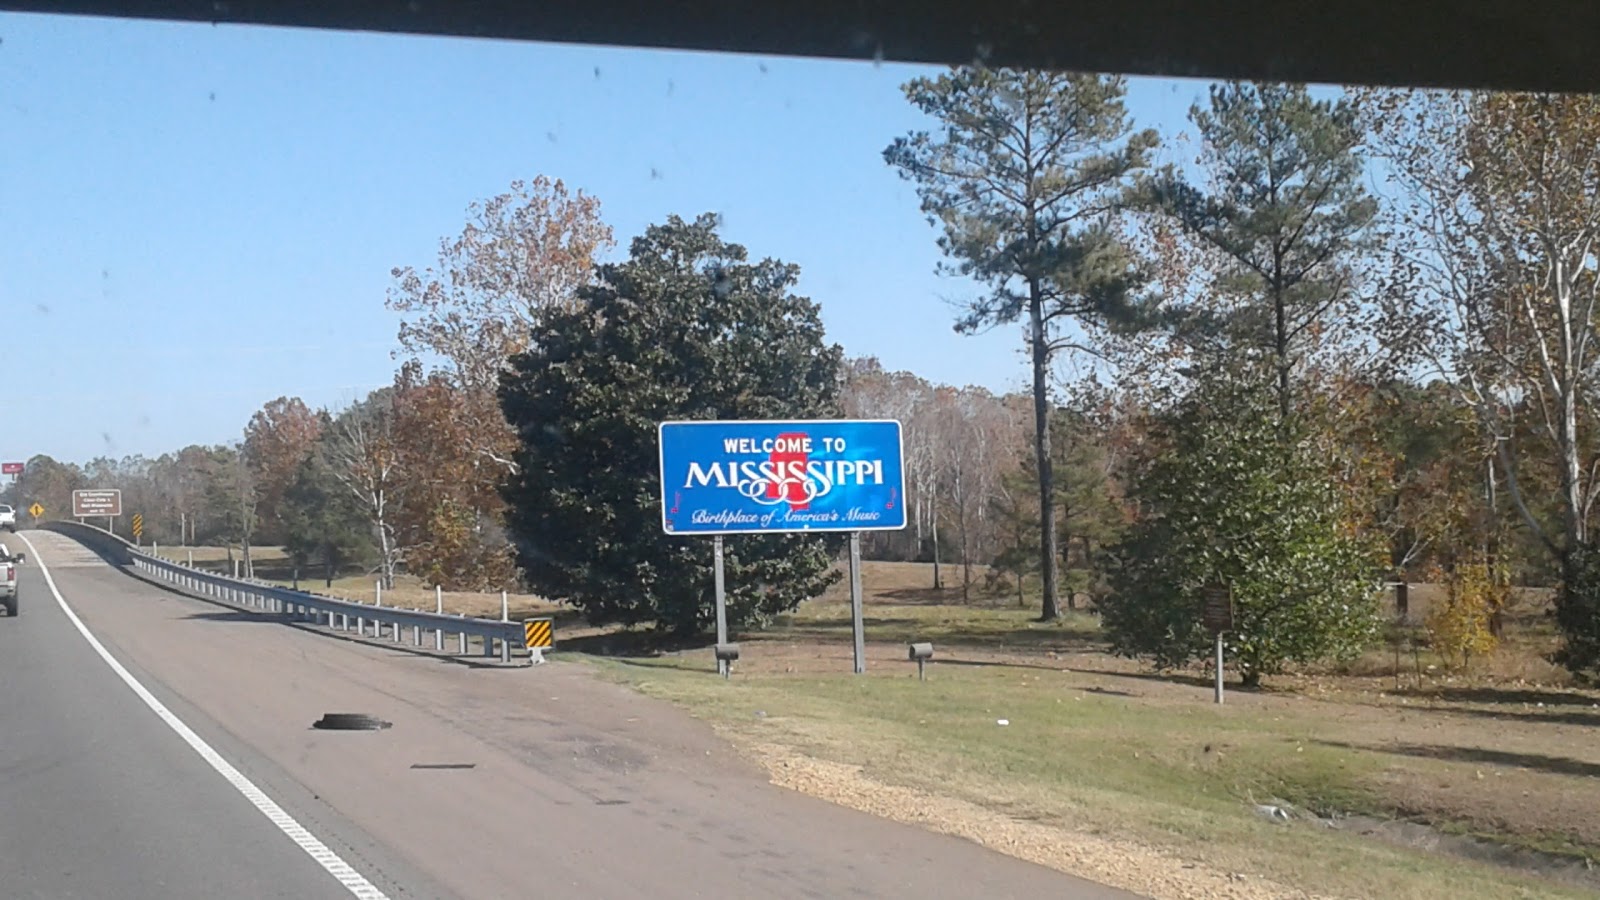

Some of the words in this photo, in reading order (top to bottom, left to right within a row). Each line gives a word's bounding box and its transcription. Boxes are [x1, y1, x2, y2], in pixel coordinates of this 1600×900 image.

[724, 438, 813, 453] WELCOME
[824, 438, 846, 452] TO
[684, 459, 884, 504] MISSISSIPPI
[692, 509, 758, 528] Birthplace
[761, 509, 777, 527] of
[778, 507, 839, 523] America's
[842, 507, 880, 521] Music
